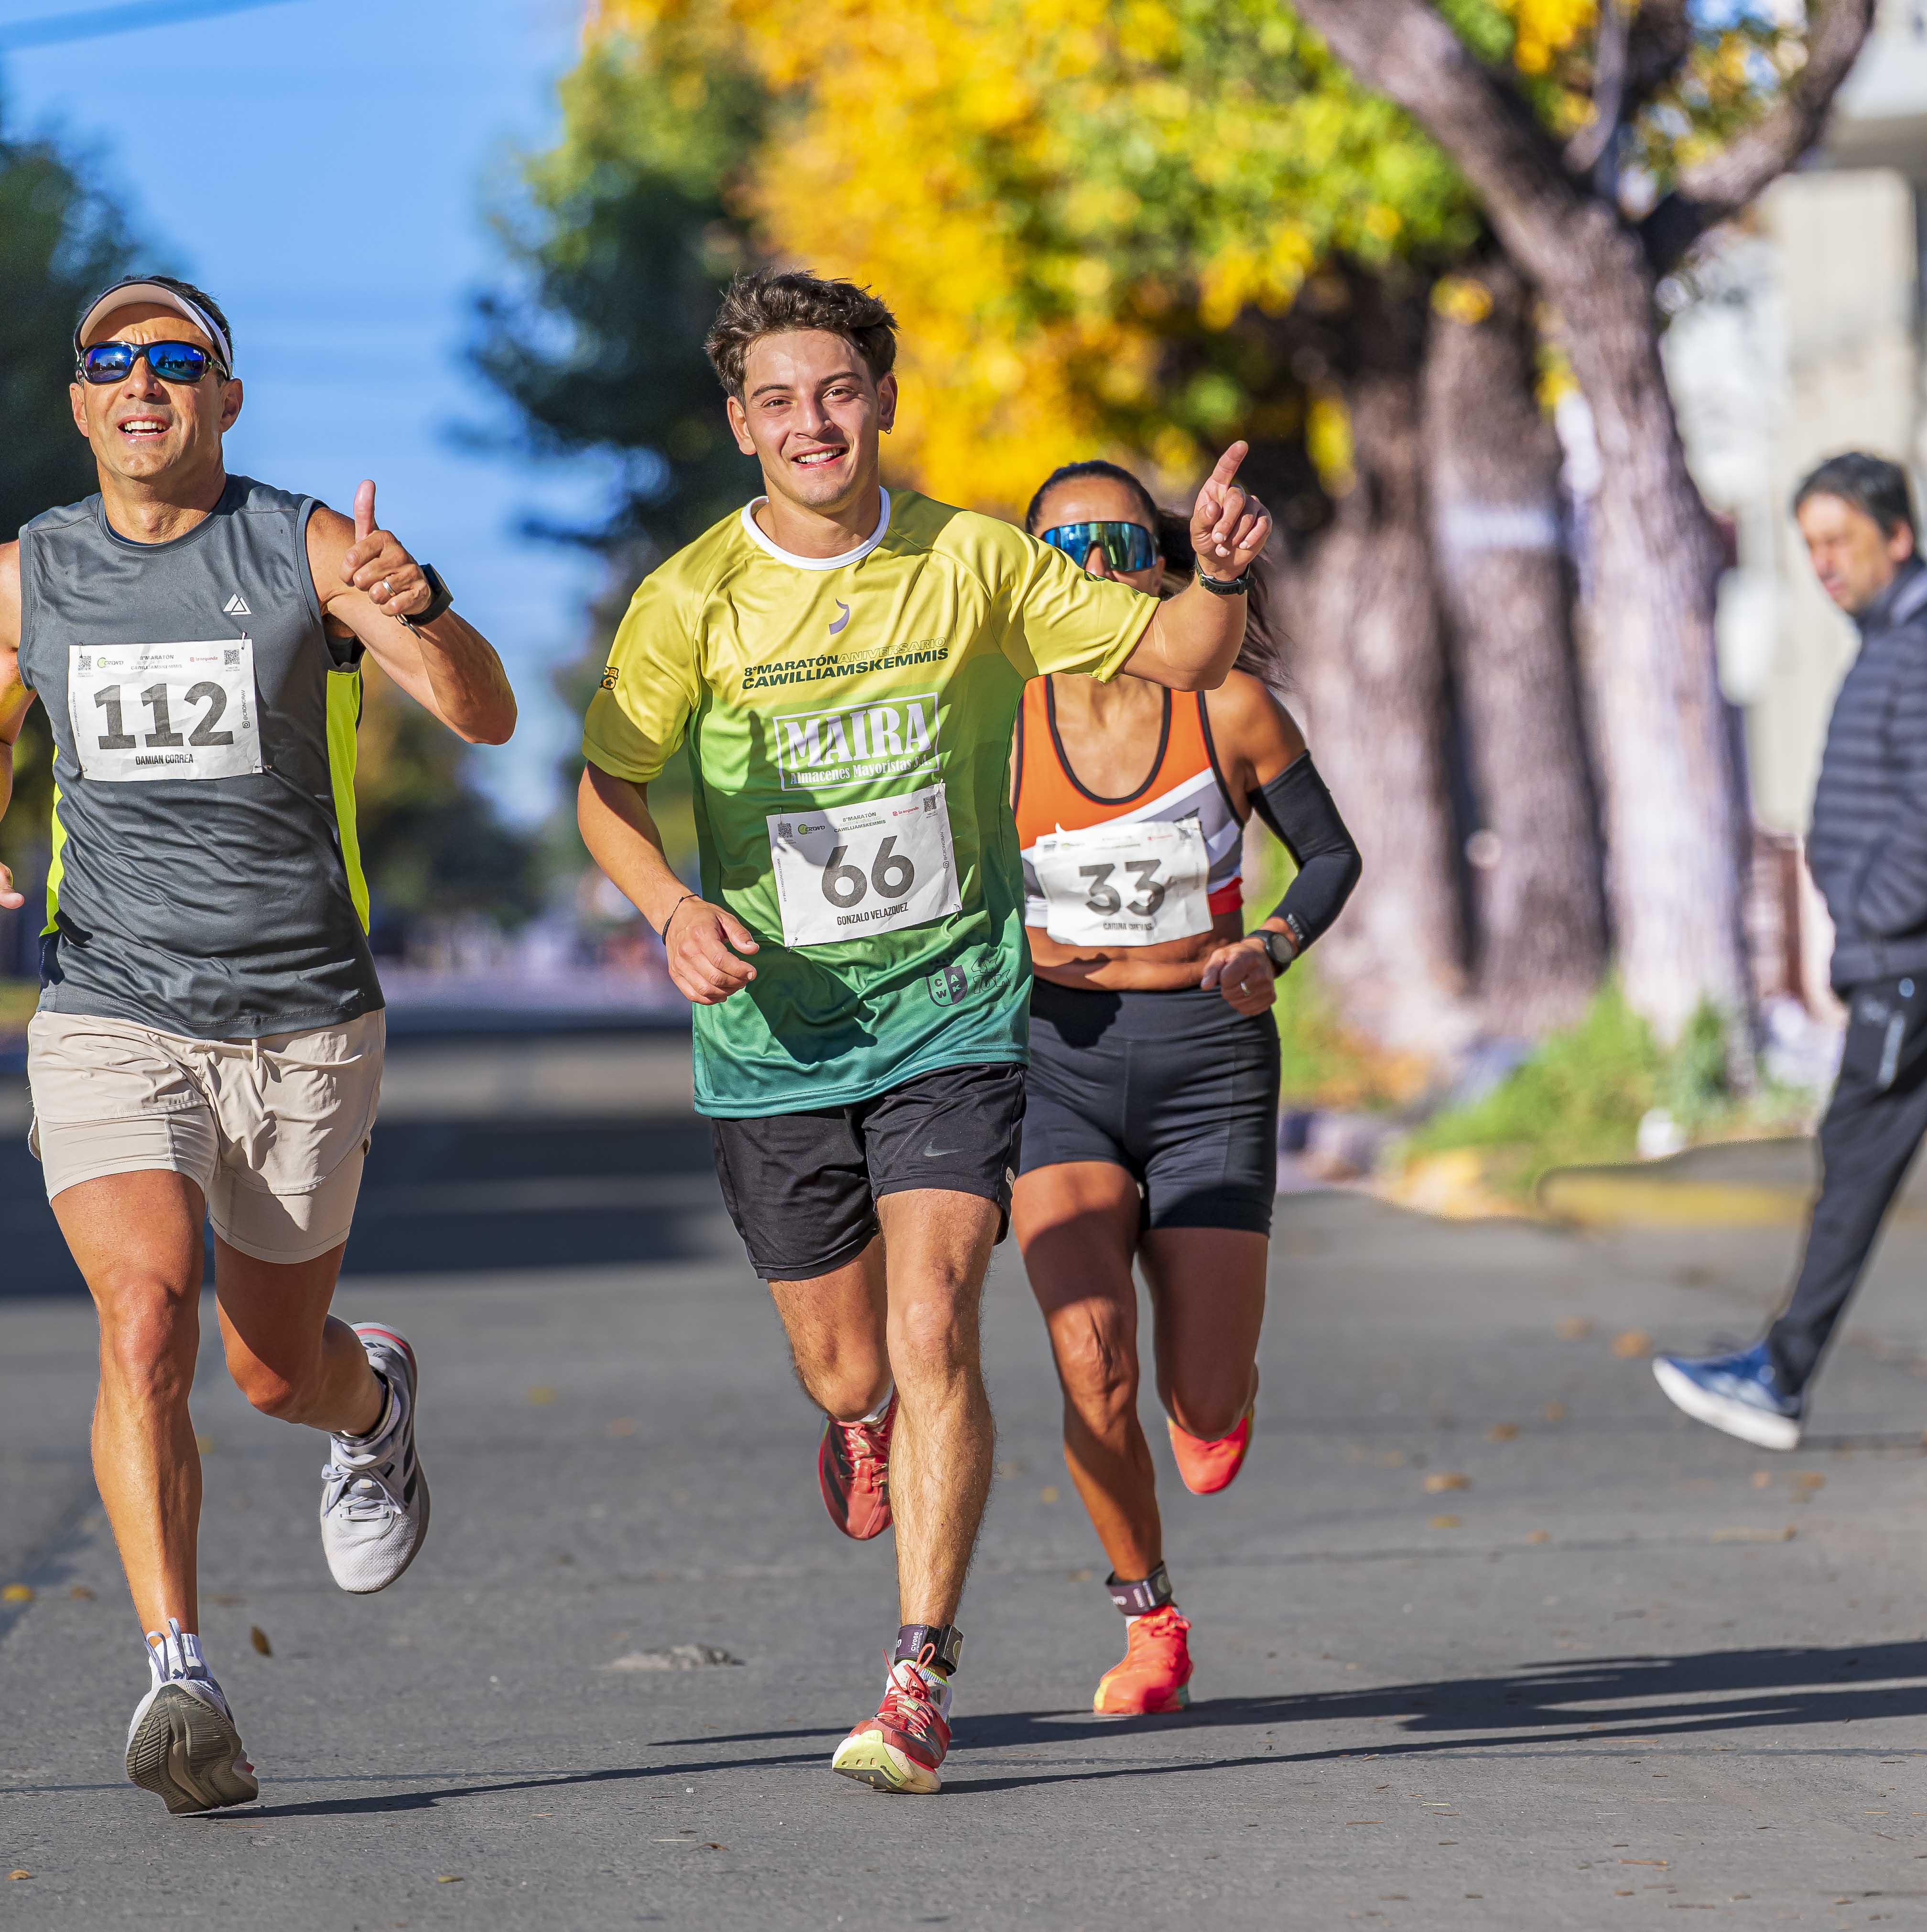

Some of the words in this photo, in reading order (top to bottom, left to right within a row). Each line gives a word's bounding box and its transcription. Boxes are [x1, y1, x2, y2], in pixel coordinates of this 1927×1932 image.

[742, 648, 948, 690] CAWILLIAMSKEMMIS
[94, 681, 234, 749] 112
[784, 703, 931, 768] MAIRA
[136, 755, 164, 765] DAMIAN
[165, 754, 194, 764] CORREA
[790, 767, 850, 784] Almacenes
[853, 758, 911, 778] Mayoristas
[822, 835, 915, 908] 66
[1078, 859, 1165, 917] 33
[837, 912, 869, 926] GONZALO
[870, 902, 909, 919] VELAZQUEZ
